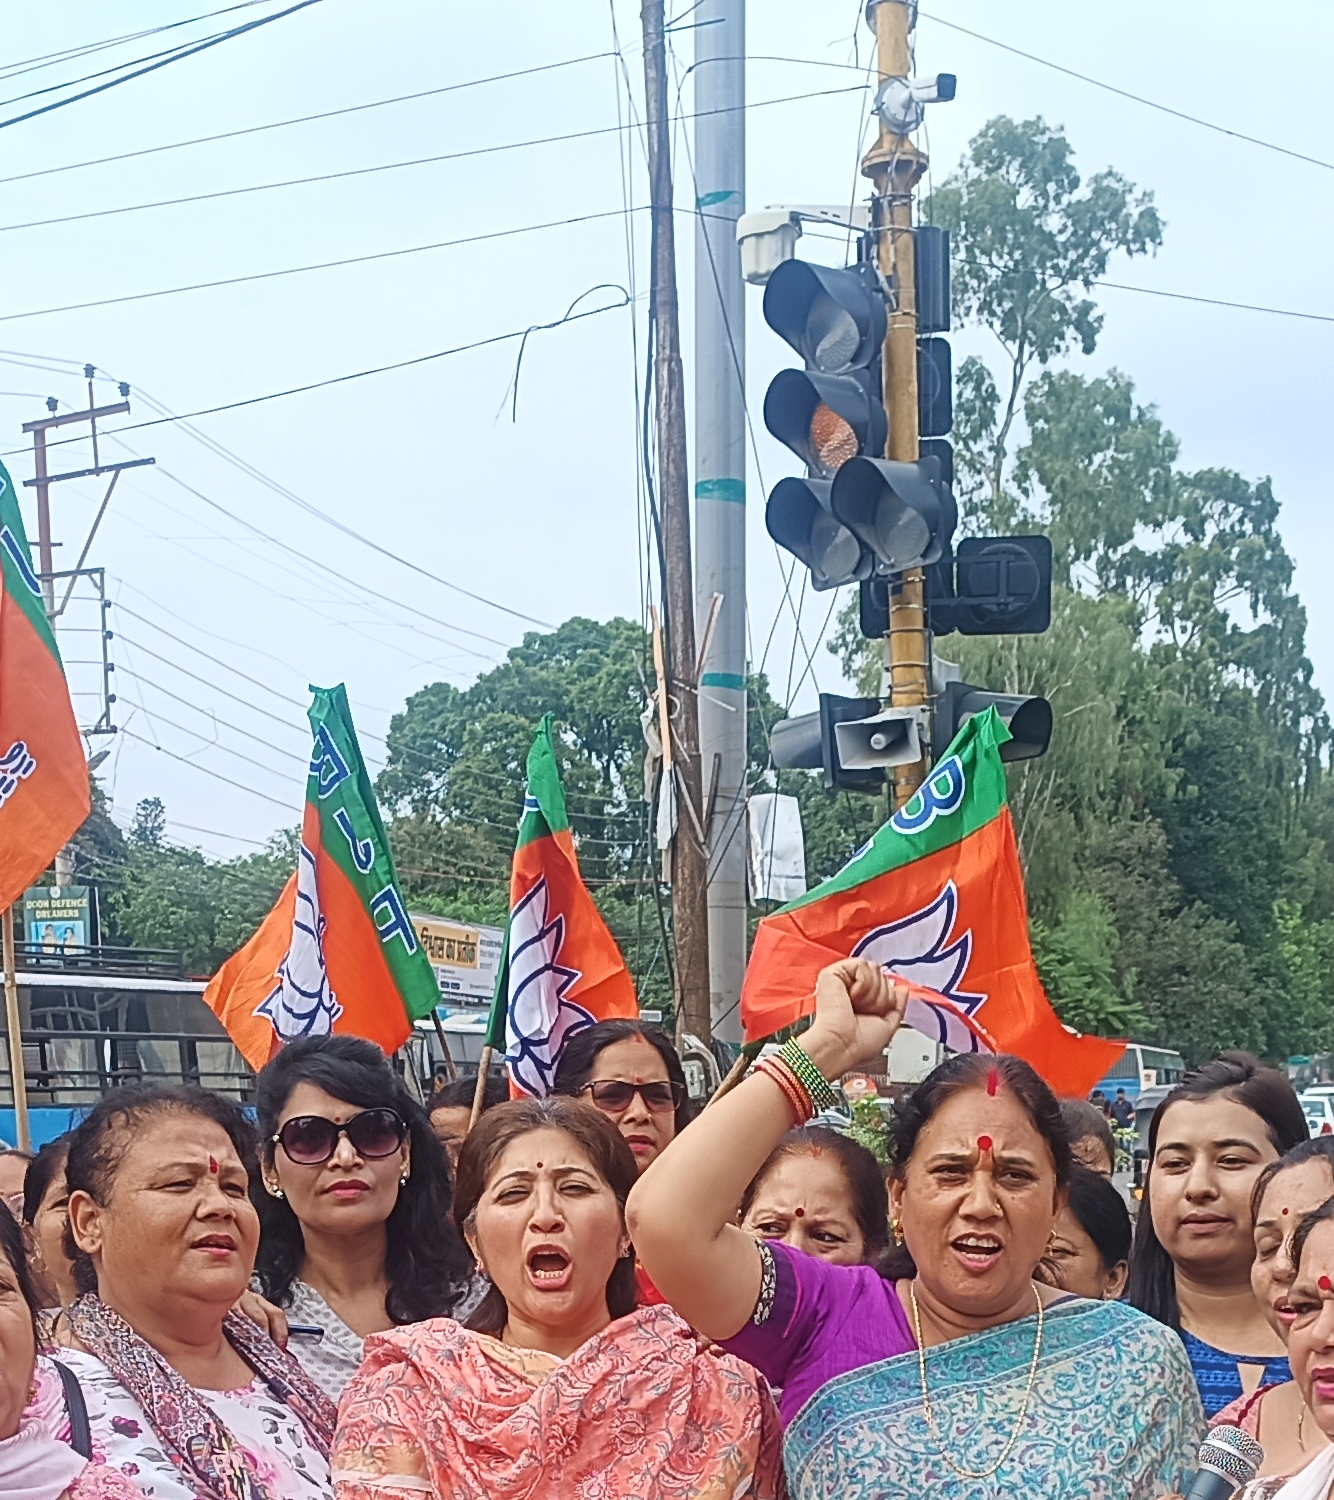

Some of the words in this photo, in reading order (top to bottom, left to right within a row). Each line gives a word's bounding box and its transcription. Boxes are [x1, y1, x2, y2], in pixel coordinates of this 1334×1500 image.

[26, 899, 49, 909] DOON
[51, 898, 88, 908] DEFENCE
[35, 909, 80, 918] DREAMERS
